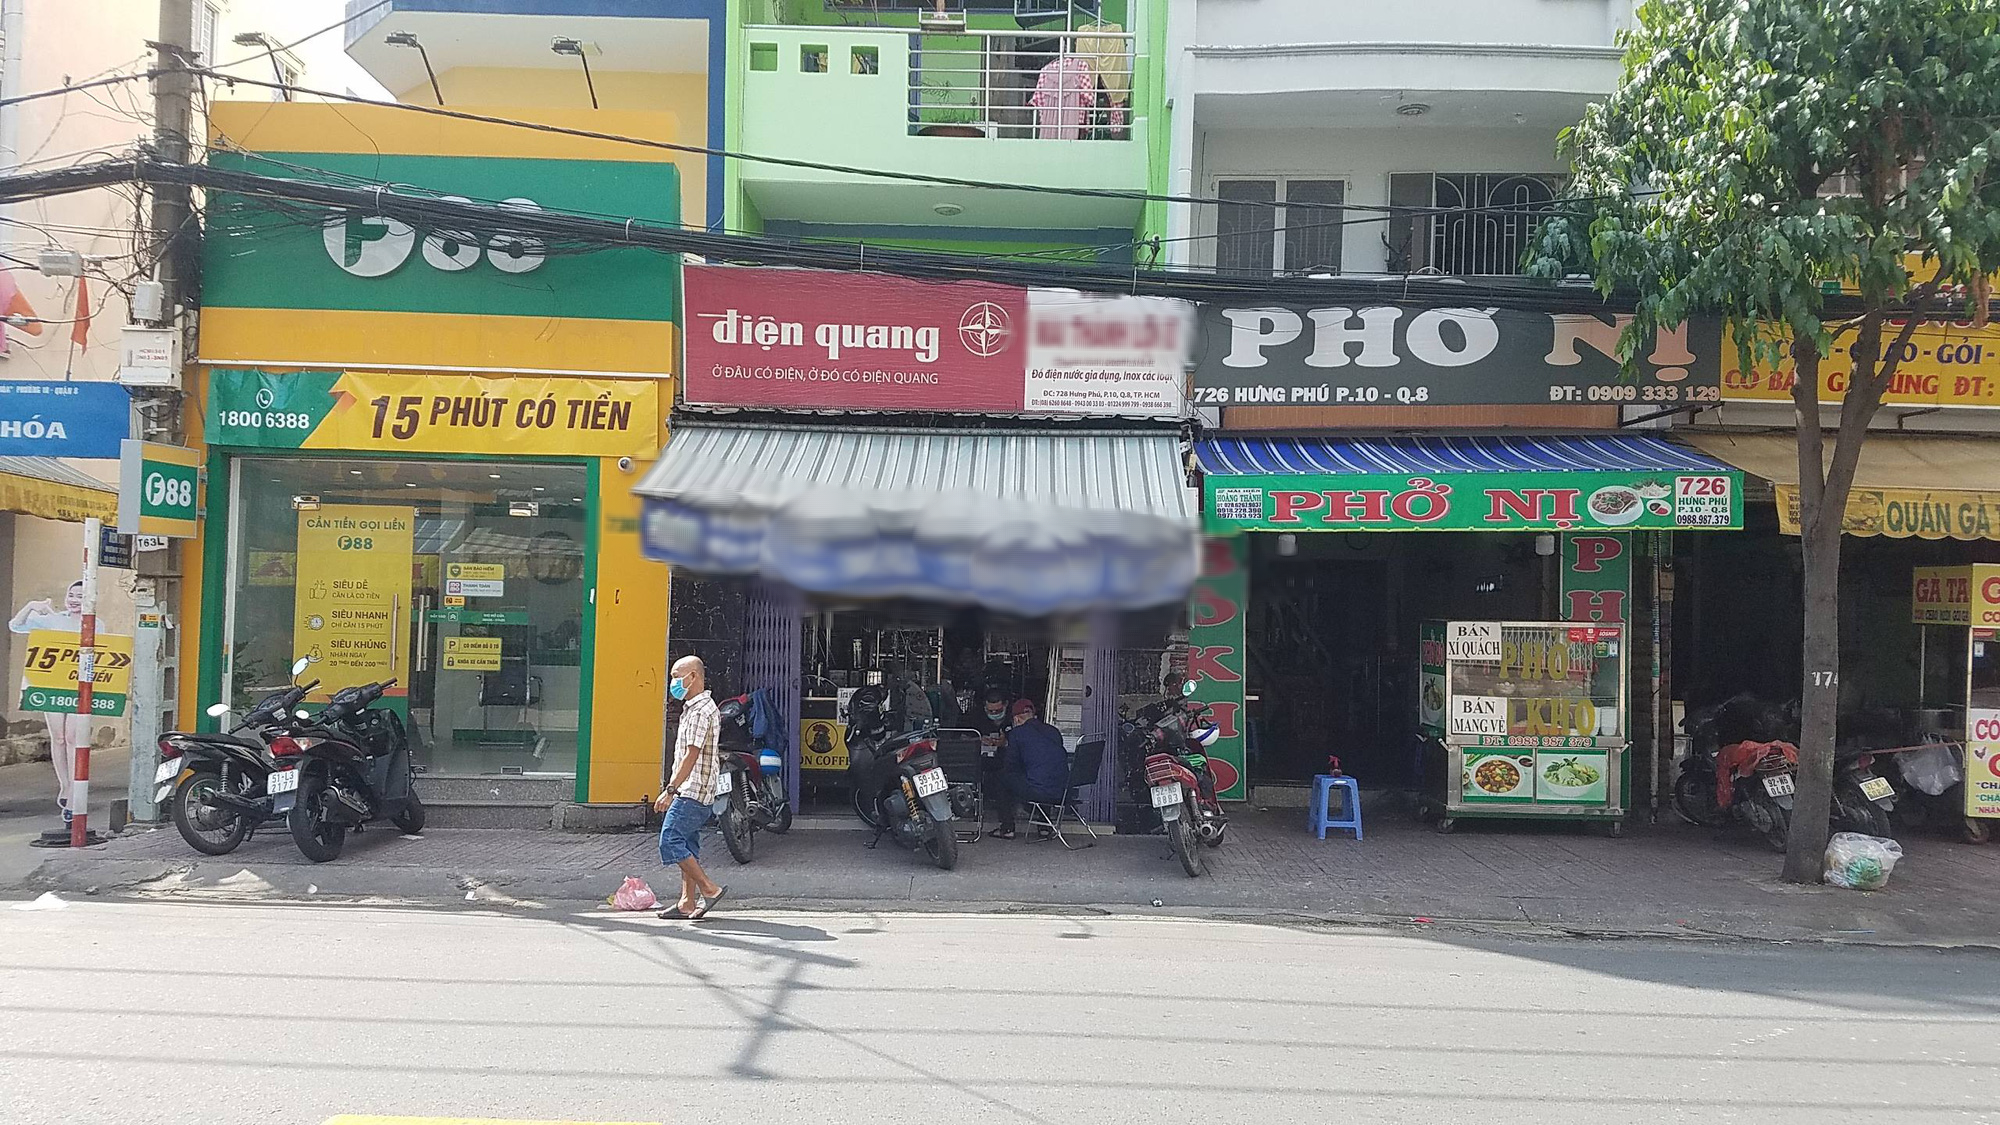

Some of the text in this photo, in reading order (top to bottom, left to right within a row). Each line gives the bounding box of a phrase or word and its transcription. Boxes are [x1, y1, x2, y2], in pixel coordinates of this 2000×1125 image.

[697, 309, 940, 363] điện quang
[1936, 337, 1983, 364] GỎI
[712, 364, 939, 385] Ở ĐÂU CÓ ĐIỆN, Ở ĐÓ CÓ ĐIỆN QUANG
[1045, 368, 1062, 382] điện
[1063, 369, 1083, 380] nước
[1085, 370, 1098, 382] gia
[1098, 370, 1122, 383] dụng,
[1123, 371, 1141, 381] Inox
[1142, 371, 1156, 381] các
[1888, 370, 1939, 395] ÚNG
[1953, 375, 1995, 397] ĐT:
[1069, 391, 1087, 399] Hưng
[1087, 390, 1103, 398] Phú,
[1194, 387, 1229, 401] 726
[1234, 384, 1286, 402] HƯNG
[1291, 383, 1330, 402] PHÚ
[1336, 386, 1379, 402] P.10
[1396, 386, 1430, 403] Q.8
[1550, 385, 1721, 401] ĐT: 0909 333 129
[219, 411, 310, 429] 1800 6388
[370, 390, 632, 440] 15 PHÚT CÓ TIỀN
[0, 414, 68, 439] HÓA
[145, 472, 192, 507] F88
[1680, 477, 1726, 496] 726
[1268, 477, 1583, 529] PHỞ NỊ
[1678, 495, 1728, 506] HƯNG PHÚ
[1676, 514, 1730, 525] 0988.987.379
[1886, 493, 1951, 533] QUÁN
[1958, 495, 1991, 535] GÀ
[360, 520, 381, 531] GỌI
[138, 537, 165, 549] T63L
[337, 535, 374, 550] F88
[332, 580, 354, 589] SIÊU
[1916, 572, 1970, 603] GÀ TA
[332, 610, 389, 620] SIÊU NHANH
[1457, 623, 1490, 636] BÁN
[331, 638, 387, 650] SIÊU KHỦNG
[1448, 638, 1500, 657] XÍ QUÁCH
[25, 646, 105, 669] 15 PHT
[91, 699, 116, 710] 388
[1463, 697, 1495, 714] BÁN
[1454, 718, 1489, 733] MANG
[1492, 715, 1506, 733] VỀ
[1482, 736, 1593, 747] ĐT: 0988 987 379
[271, 770, 295, 783] 51-L3
[918, 771, 941, 786] 59-A3
[271, 780, 295, 793] 2177
